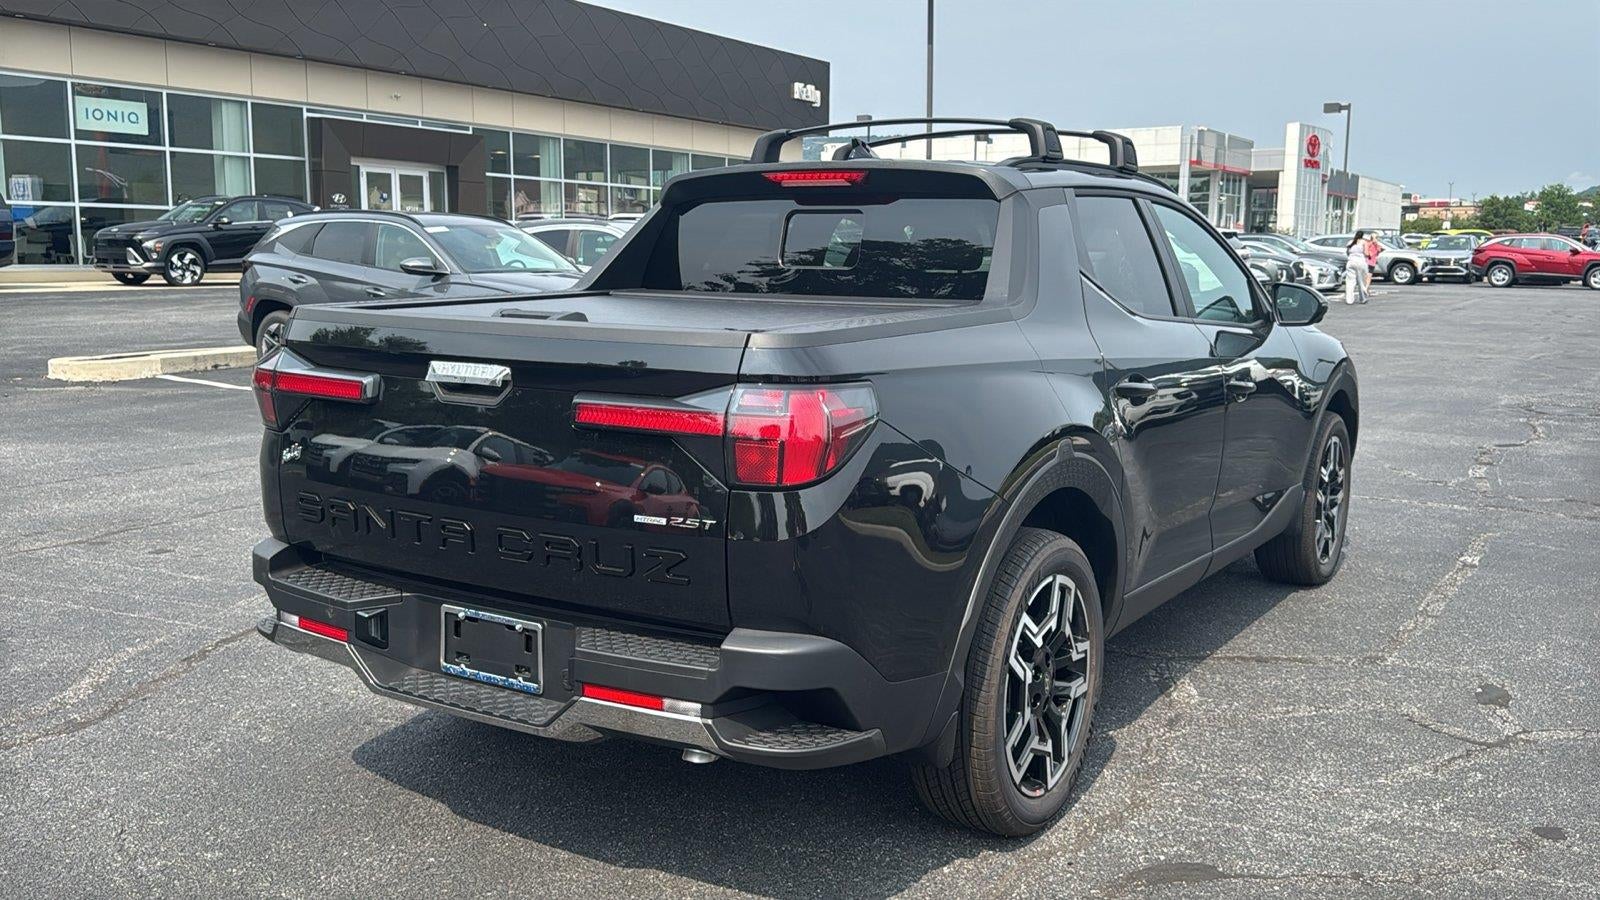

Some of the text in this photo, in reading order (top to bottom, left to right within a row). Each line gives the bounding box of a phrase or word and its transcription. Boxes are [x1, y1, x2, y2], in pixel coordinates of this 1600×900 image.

[85, 106, 139, 124] IONIQ
[297, 491, 692, 586] SANTA CRUZ
